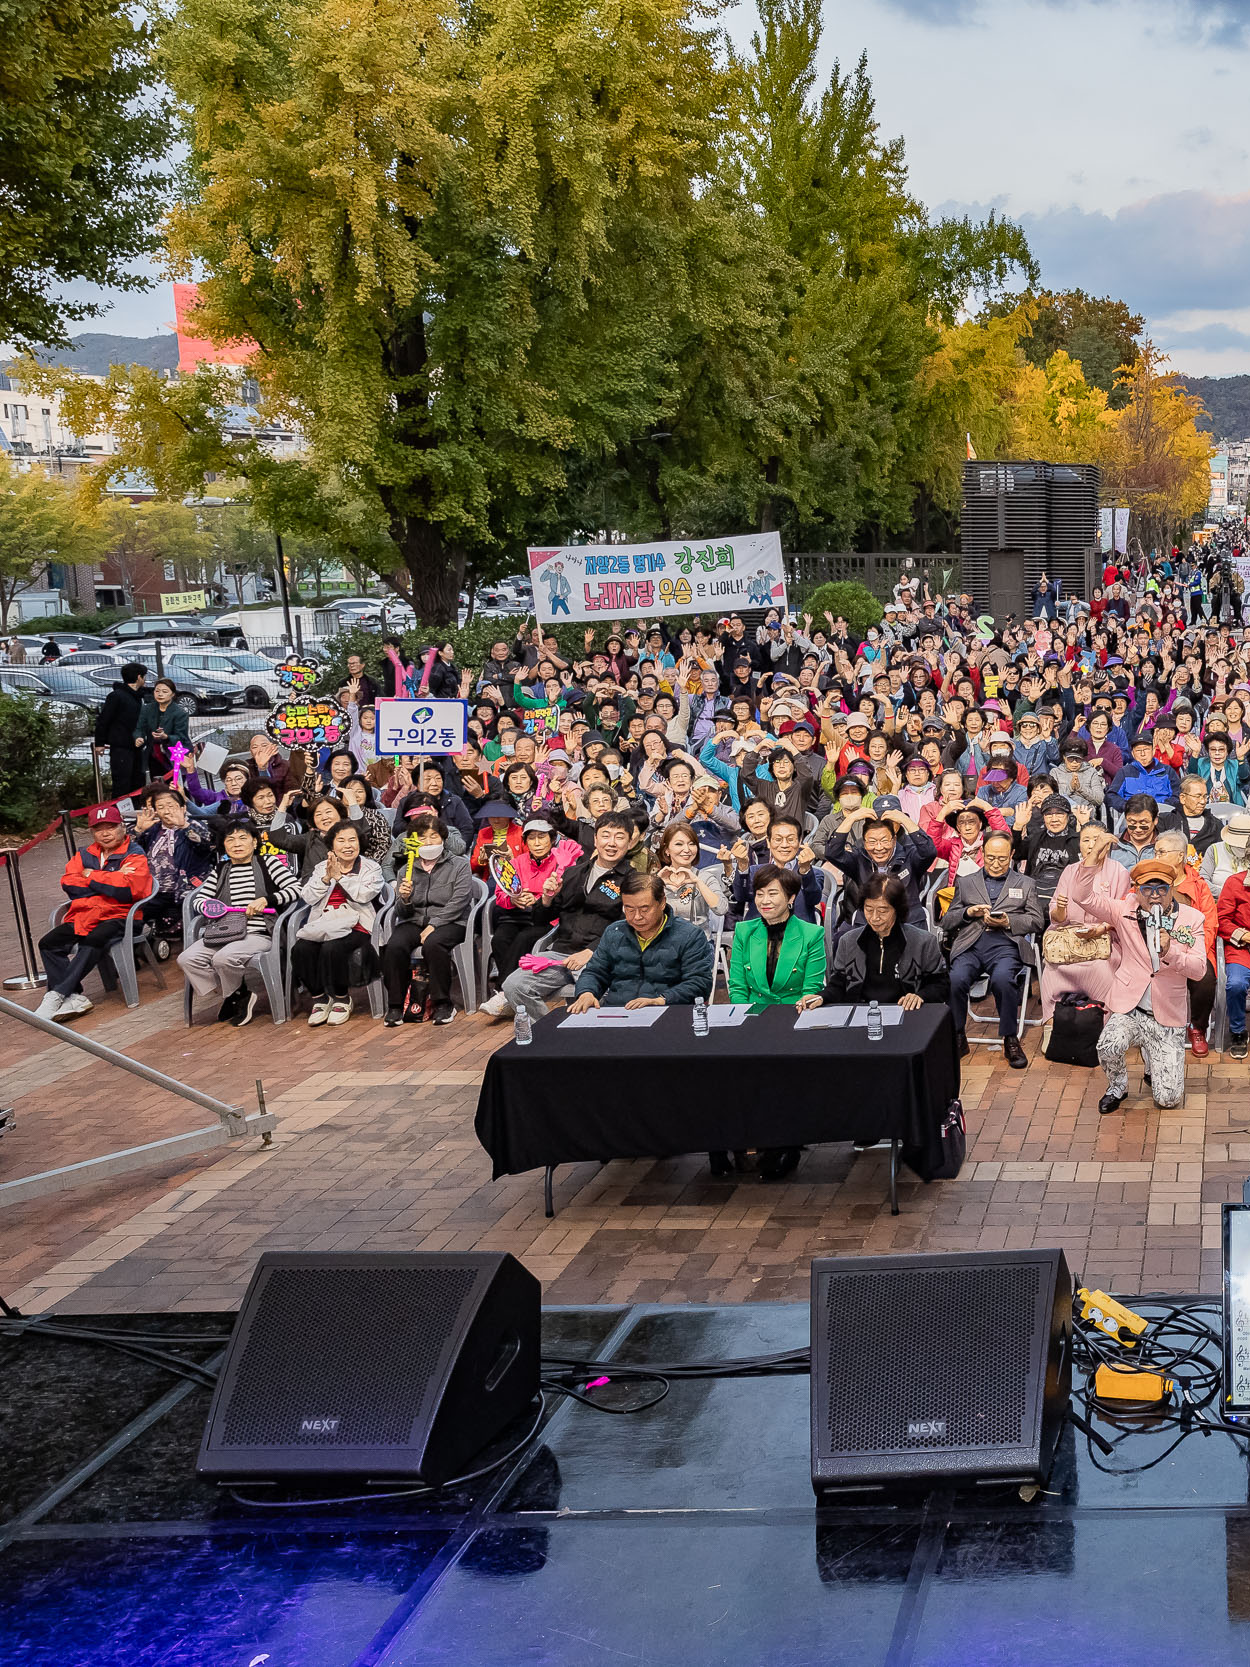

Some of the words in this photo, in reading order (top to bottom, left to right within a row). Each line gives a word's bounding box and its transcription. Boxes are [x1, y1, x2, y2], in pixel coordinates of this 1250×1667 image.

[584, 555, 630, 575] 자양2동
[632, 552, 666, 575] 명가수
[674, 544, 735, 574] 강진희
[583, 580, 655, 611] 노래자랑
[659, 577, 692, 606] 우승
[696, 583, 706, 597] 은
[710, 582, 744, 597] 나야나!
[281, 726, 340, 745] 구의2동
[387, 728, 456, 748] 구의2동
[96, 808, 109, 820] N
[302, 1418, 338, 1432] NEXT
[908, 1420, 945, 1435] NEXT
